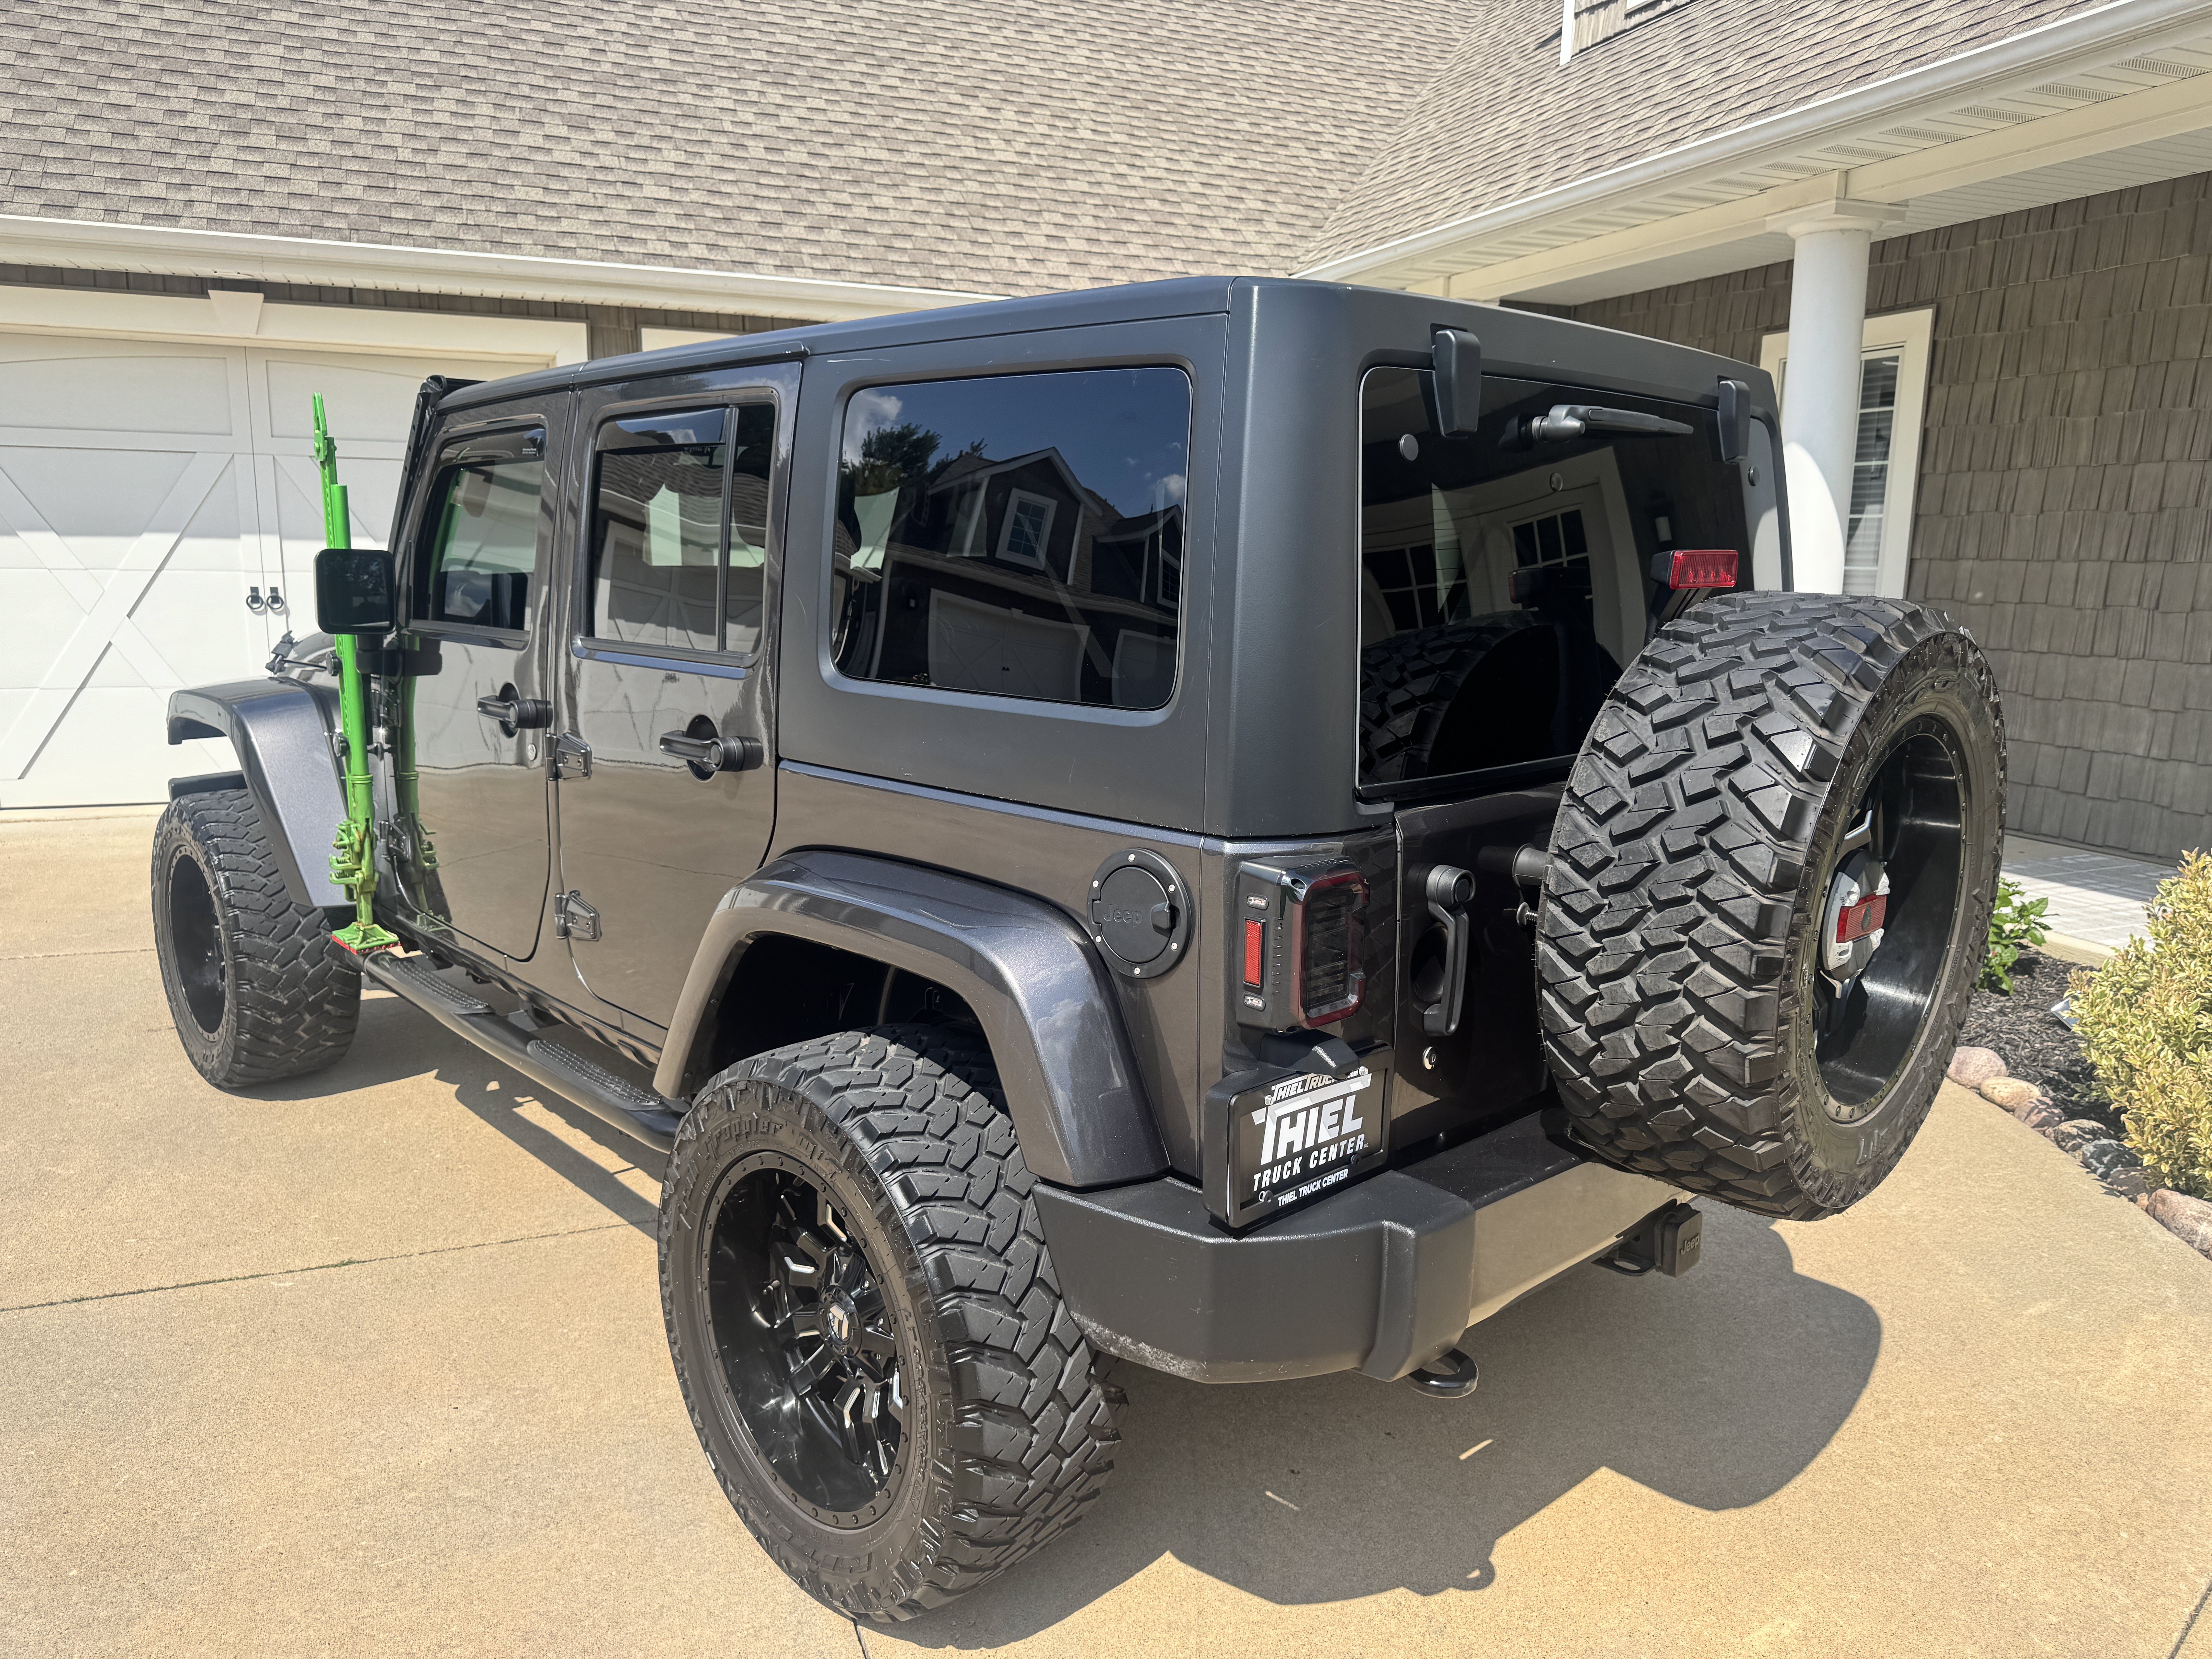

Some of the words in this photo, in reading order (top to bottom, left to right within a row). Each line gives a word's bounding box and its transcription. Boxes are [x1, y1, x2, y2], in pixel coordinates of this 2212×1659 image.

[1103, 904, 1142, 927] Jeep
[1251, 1073, 1372, 1166] THIEL
[1254, 1156, 1303, 1192] TRUCK
[1309, 1134, 1365, 1169] CENTER
[1278, 1190, 1297, 1207] THIEL
[1299, 1179, 1322, 1198] TRUCK
[1322, 1168, 1348, 1188] CENTER
[1681, 1234, 1700, 1255] Jeep
